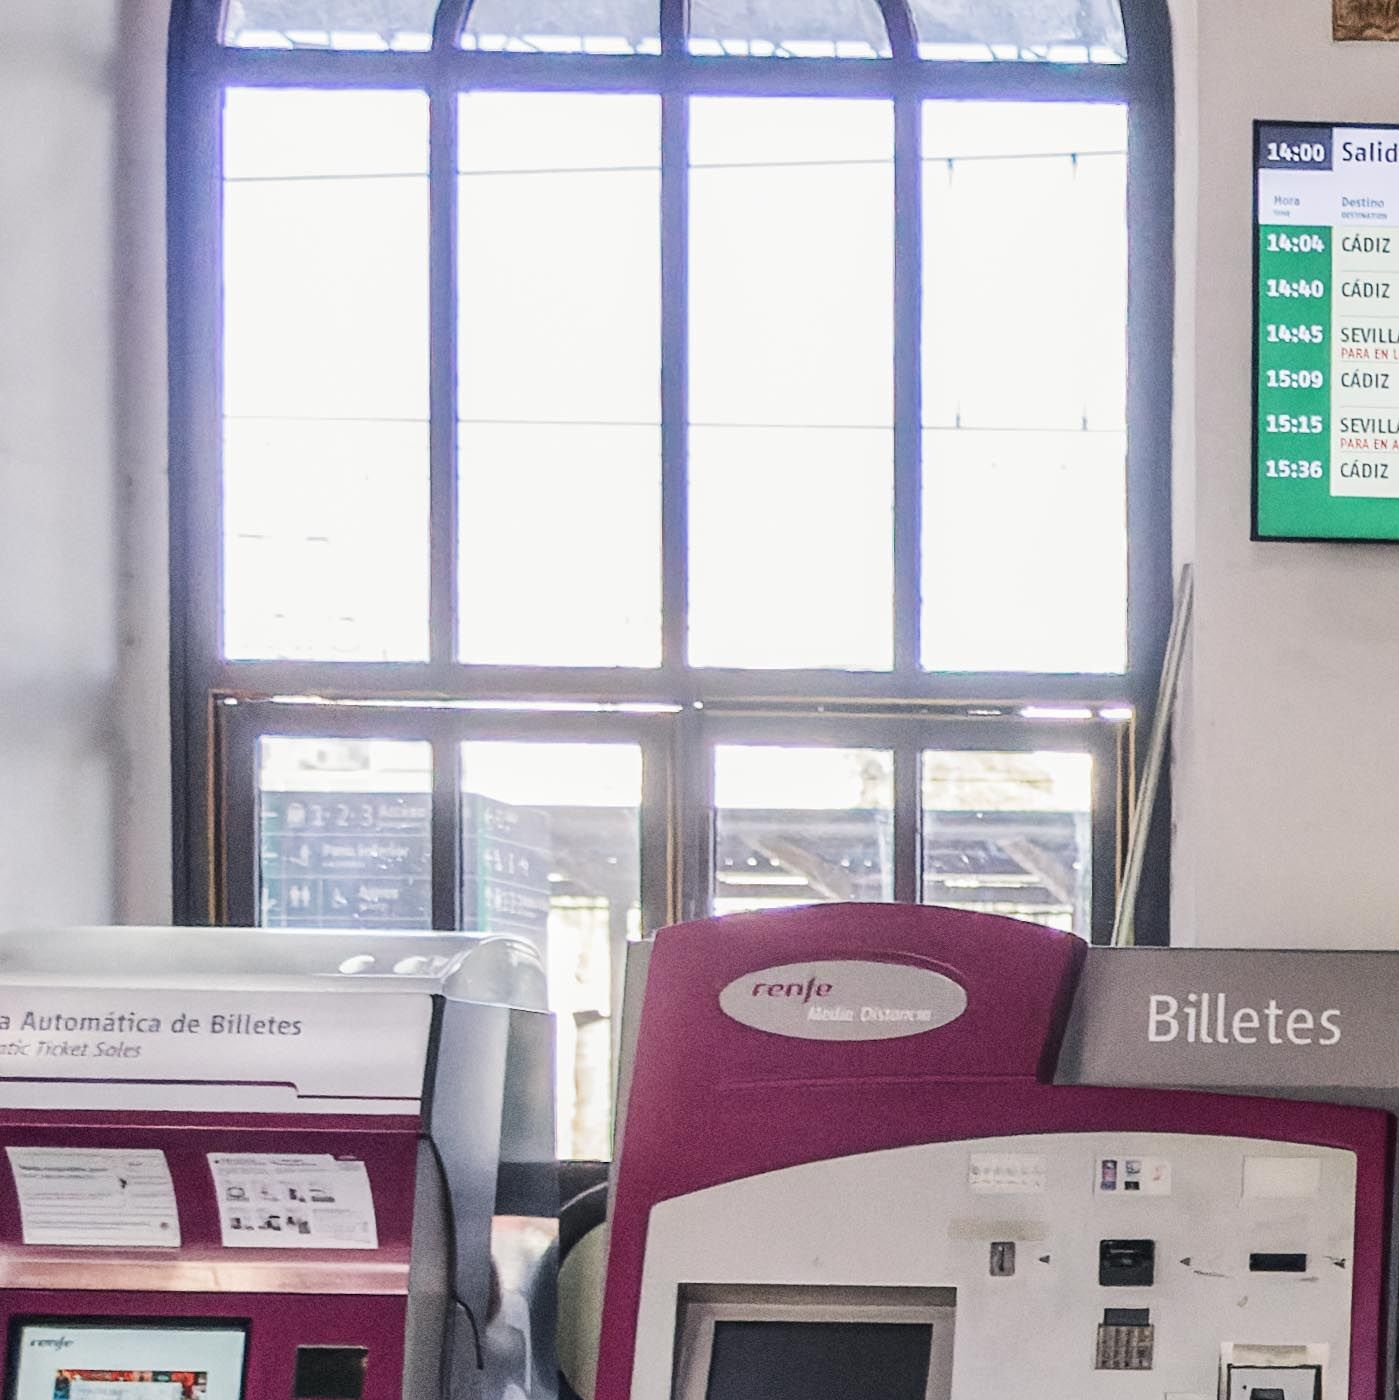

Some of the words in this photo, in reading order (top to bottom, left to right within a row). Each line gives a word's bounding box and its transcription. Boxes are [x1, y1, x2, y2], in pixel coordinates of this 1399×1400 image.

[1267, 142, 1325, 162] 14:00
[1274, 196, 1300, 206] Hora
[1341, 197, 1385, 208] Destino
[1267, 233, 1325, 252] 14:04
[1342, 236, 1391, 254] CÁDIZ
[1267, 278, 1324, 299] 14:40
[1341, 280, 1390, 299] CÁDIZ
[1267, 324, 1323, 343] 14:45
[1341, 348, 1370, 359] PARA
[1375, 349, 1389, 360] EN
[1267, 369, 1323, 388] 15:09
[1341, 370, 1390, 389] CÁDIZ
[1266, 414, 1322, 434] 15:15
[1340, 438, 1369, 450] PARA
[1374, 439, 1388, 450] EN
[1266, 460, 1322, 479] 15:36
[1341, 461, 1389, 479] CÁDIZ
[752, 976, 833, 1004] renfe
[20, 1011, 161, 1033] Automática
[171, 1013, 201, 1034] de
[211, 1015, 303, 1036] Billetes
[1146, 993, 1343, 1048] Billetes
[37, 1041, 88, 1057] Ticket
[93, 1042, 142, 1058] Sales
[30, 1336, 73, 1351] renfe
